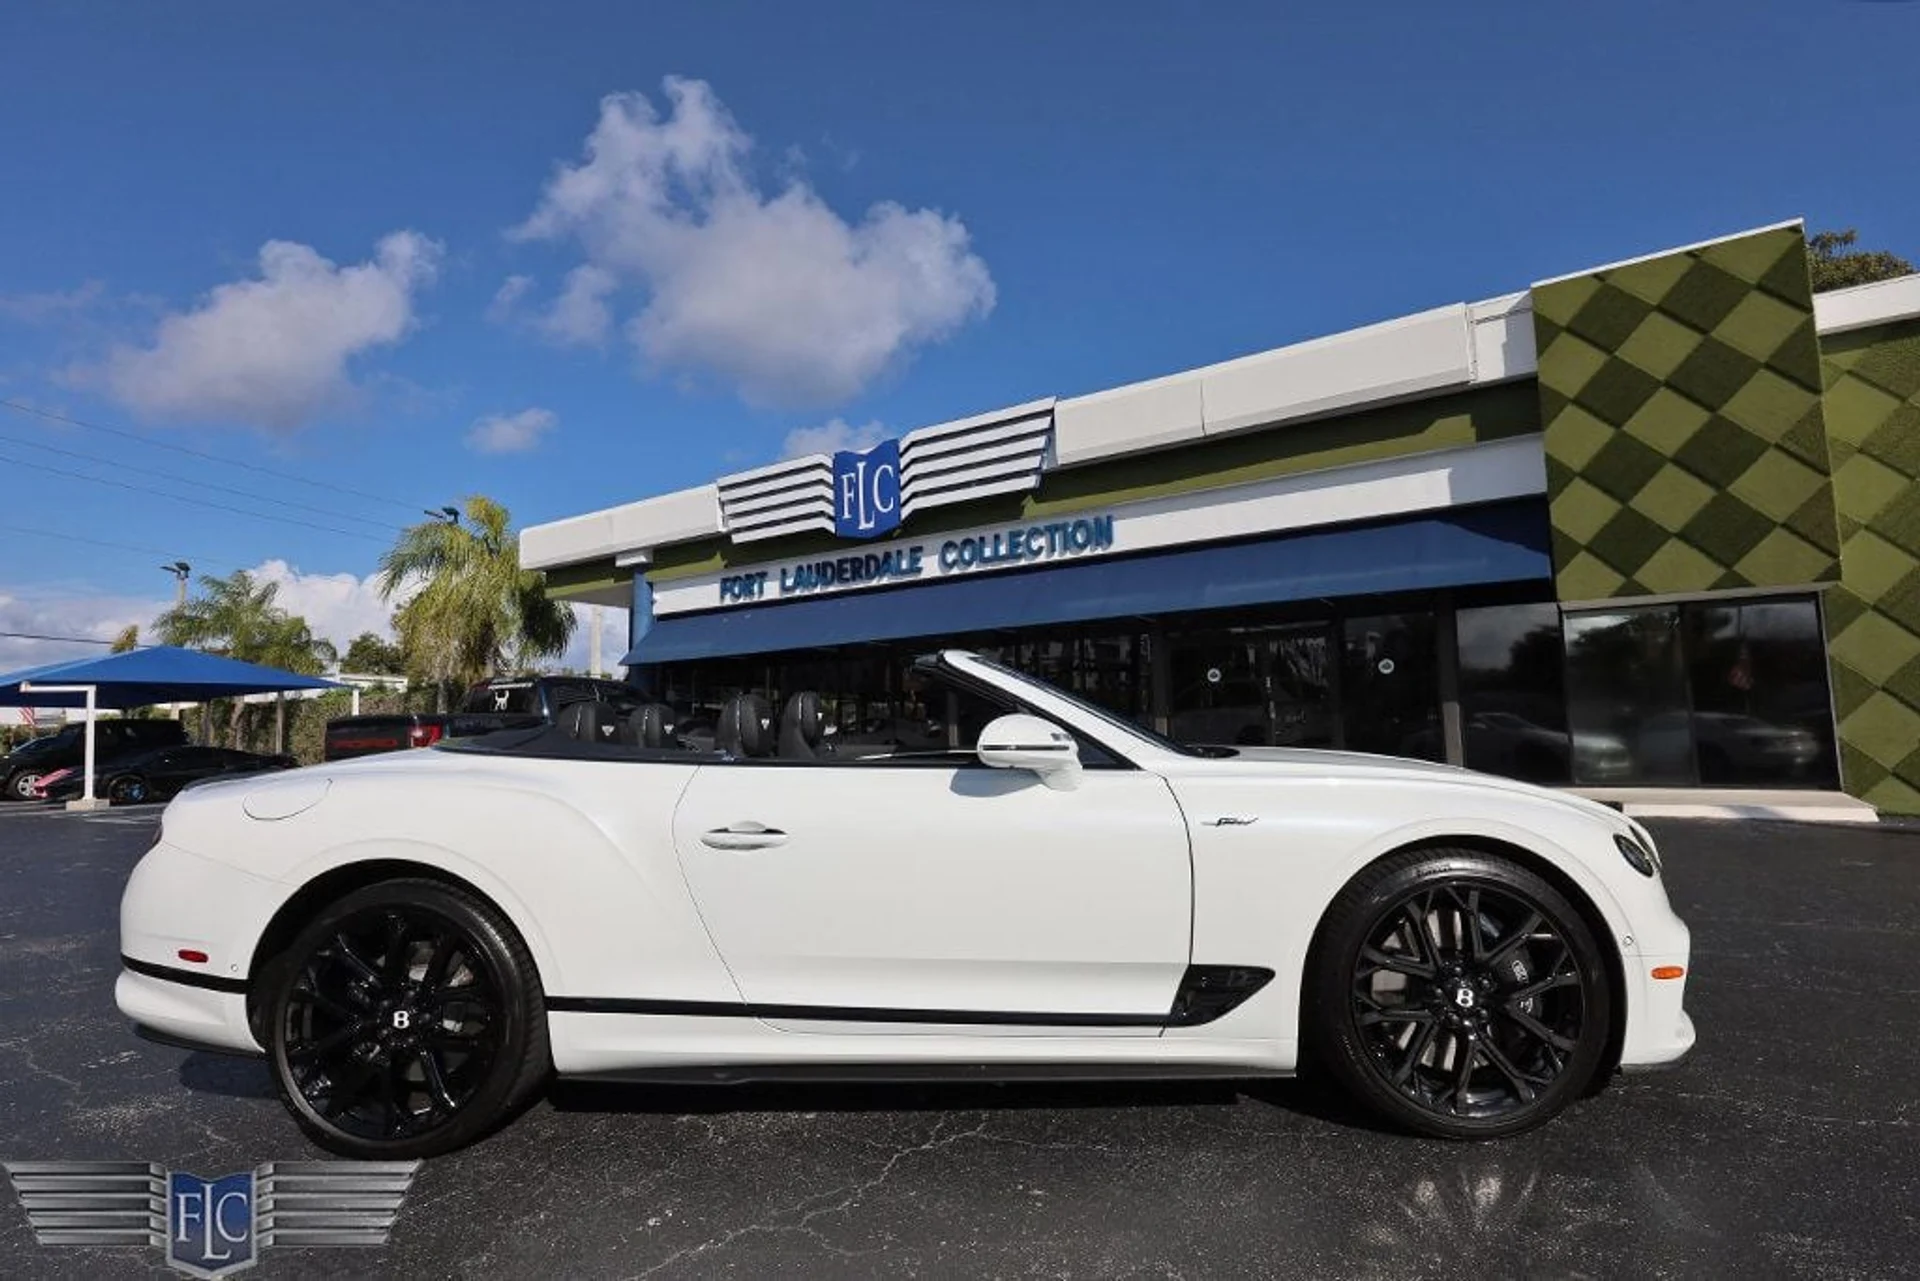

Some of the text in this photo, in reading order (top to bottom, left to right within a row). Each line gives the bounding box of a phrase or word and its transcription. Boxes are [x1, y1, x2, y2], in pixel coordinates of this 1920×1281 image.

[841, 461, 894, 530] FLC
[720, 515, 1115, 602] FORT LAUDERDALE COLLECTION
[393, 1010, 410, 1029] B
